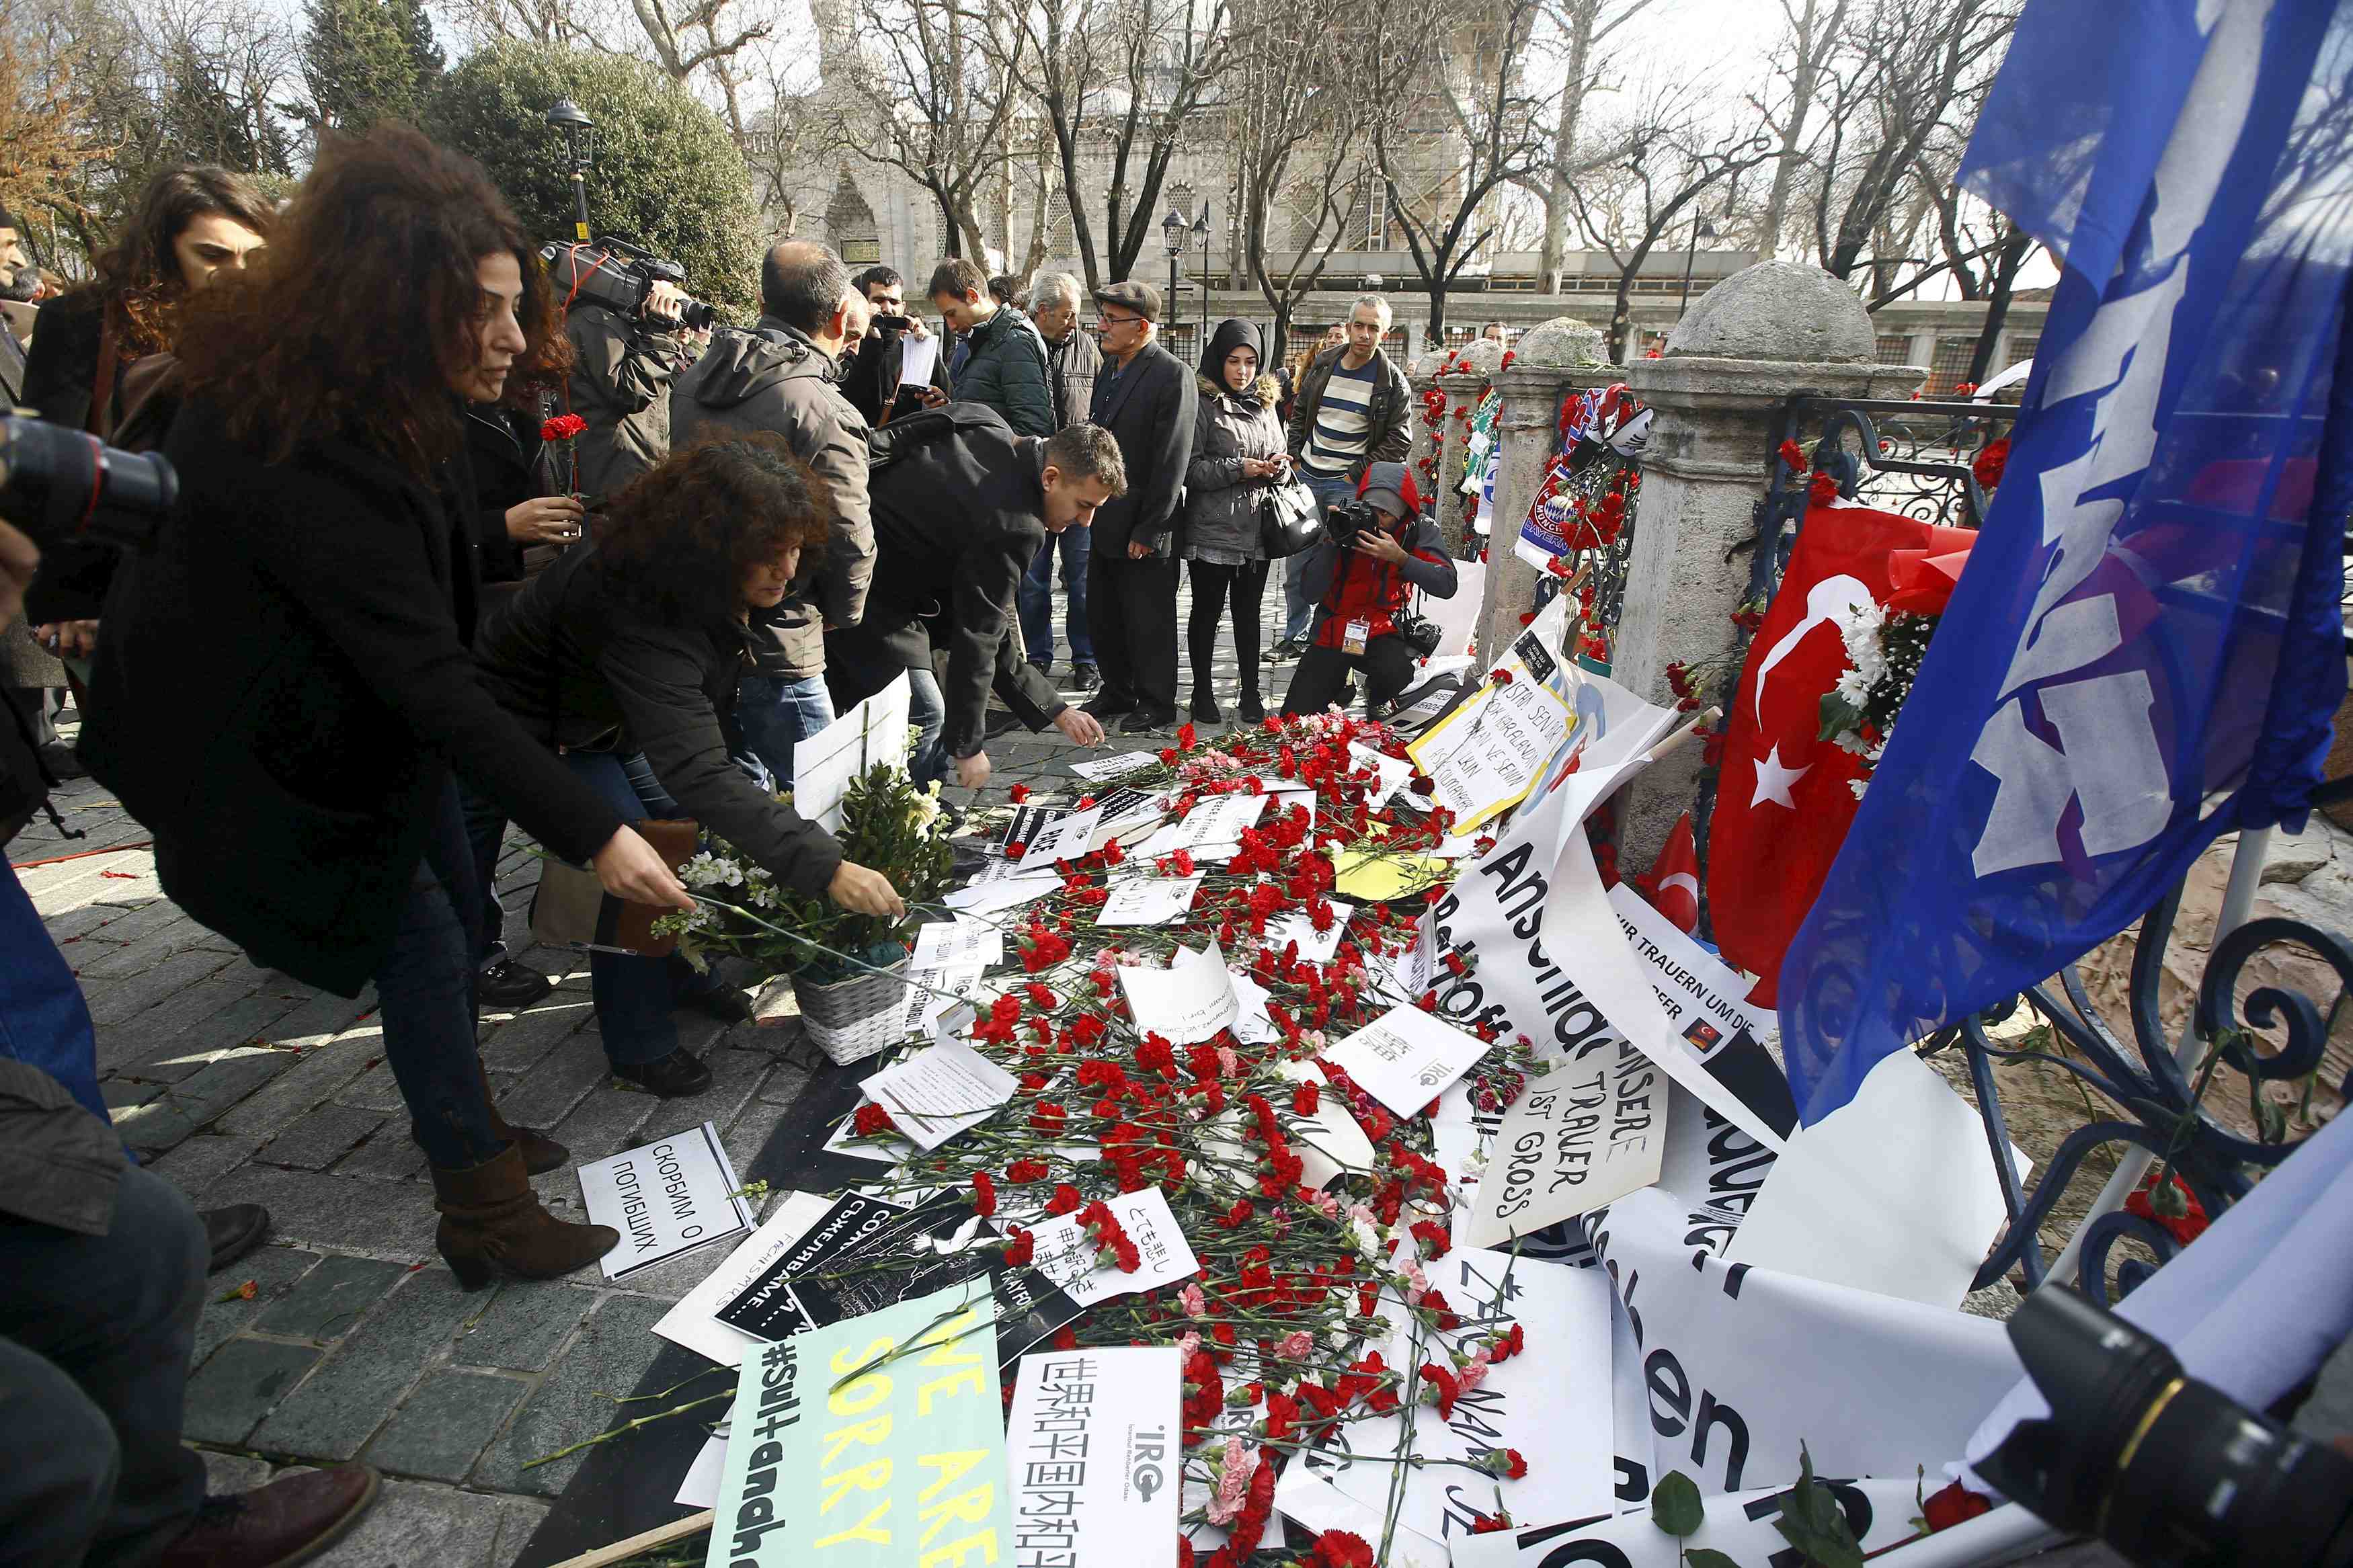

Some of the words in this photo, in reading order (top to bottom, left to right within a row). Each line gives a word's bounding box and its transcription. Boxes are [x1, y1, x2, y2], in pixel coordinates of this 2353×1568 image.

[1524, 518, 1568, 550] BAYERN
[1029, 827, 1064, 855] PACE
[1637, 937, 1709, 999] TRAUERN
[1705, 994, 1734, 1022] UM
[1524, 1087, 1561, 1120] IST
[1548, 1071, 1607, 1194] TRAUER
[612, 1161, 658, 1253] ПОГИБШИХ
[652, 1145, 696, 1220] СКОРБИМ
[1496, 1131, 1545, 1219] GROSS
[1129, 1207, 1170, 1273] とても悲し
[917, 1307, 986, 1417] WE
[813, 1335, 894, 1550] SORRY
[917, 1448, 1000, 1568] ARE
